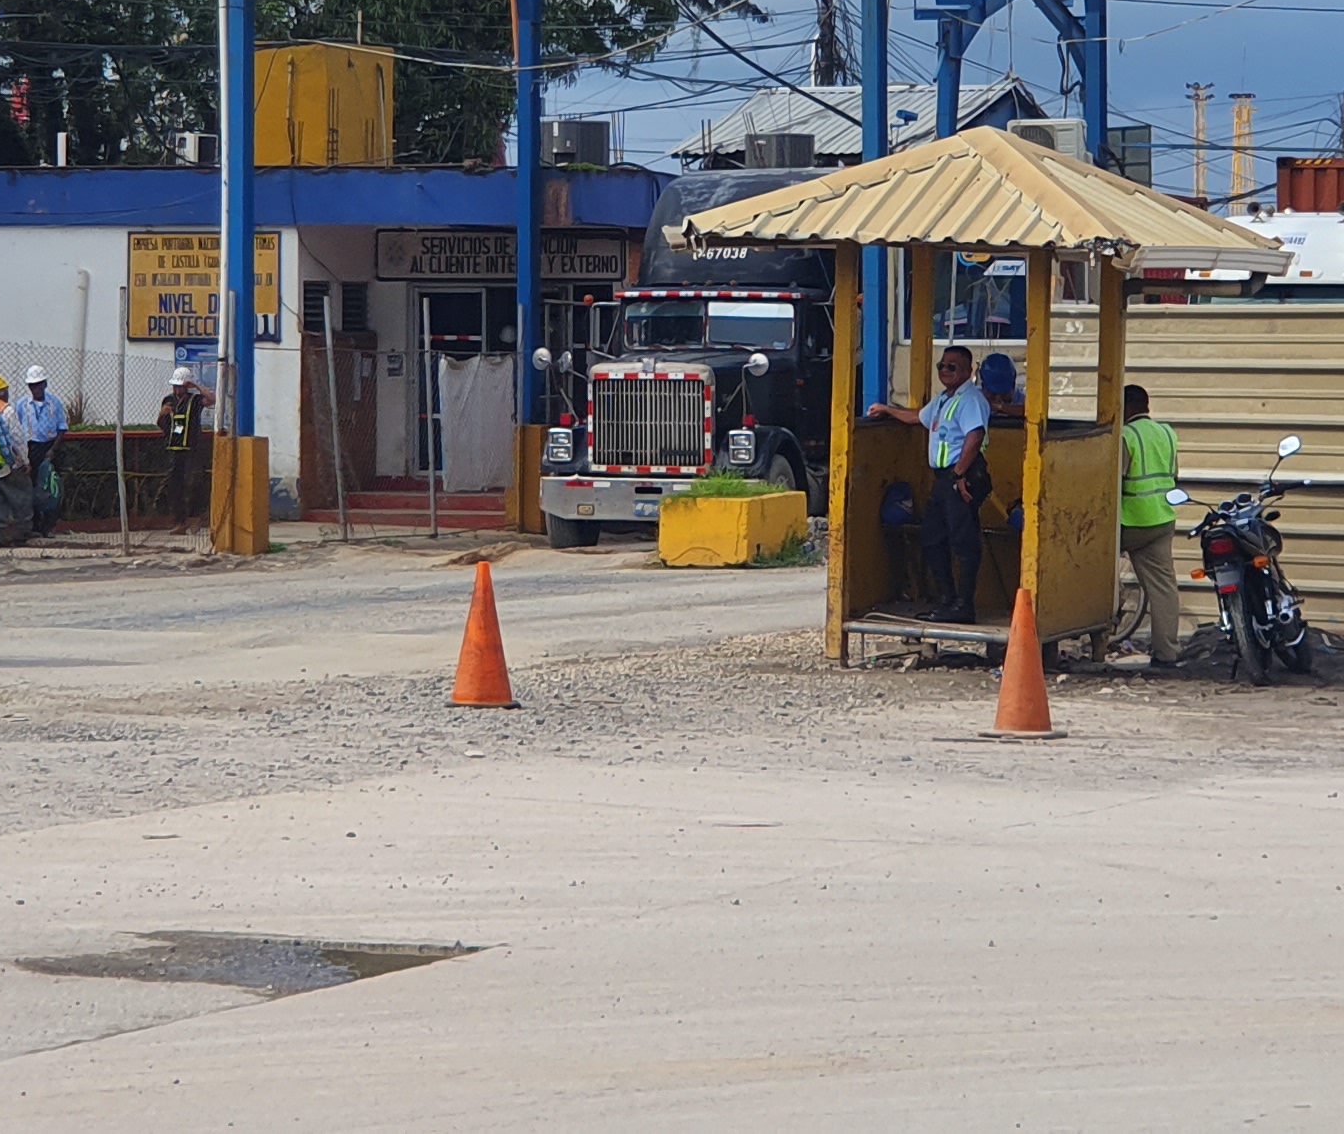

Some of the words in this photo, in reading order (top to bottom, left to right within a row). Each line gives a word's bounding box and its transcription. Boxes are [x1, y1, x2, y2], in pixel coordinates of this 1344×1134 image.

[421, 236, 491, 255] SERVICIOS
[494, 237, 510, 255] DE
[410, 255, 425, 273] AL
[429, 255, 481, 273] CLIENTE
[486, 255, 517, 273] INTE
[547, 255, 557, 273] Y
[561, 254, 619, 273] EXTERNO
[159, 293, 197, 314] NIVEL
[208, 293, 221, 314] D
[148, 316, 220, 336] PROTECCI
